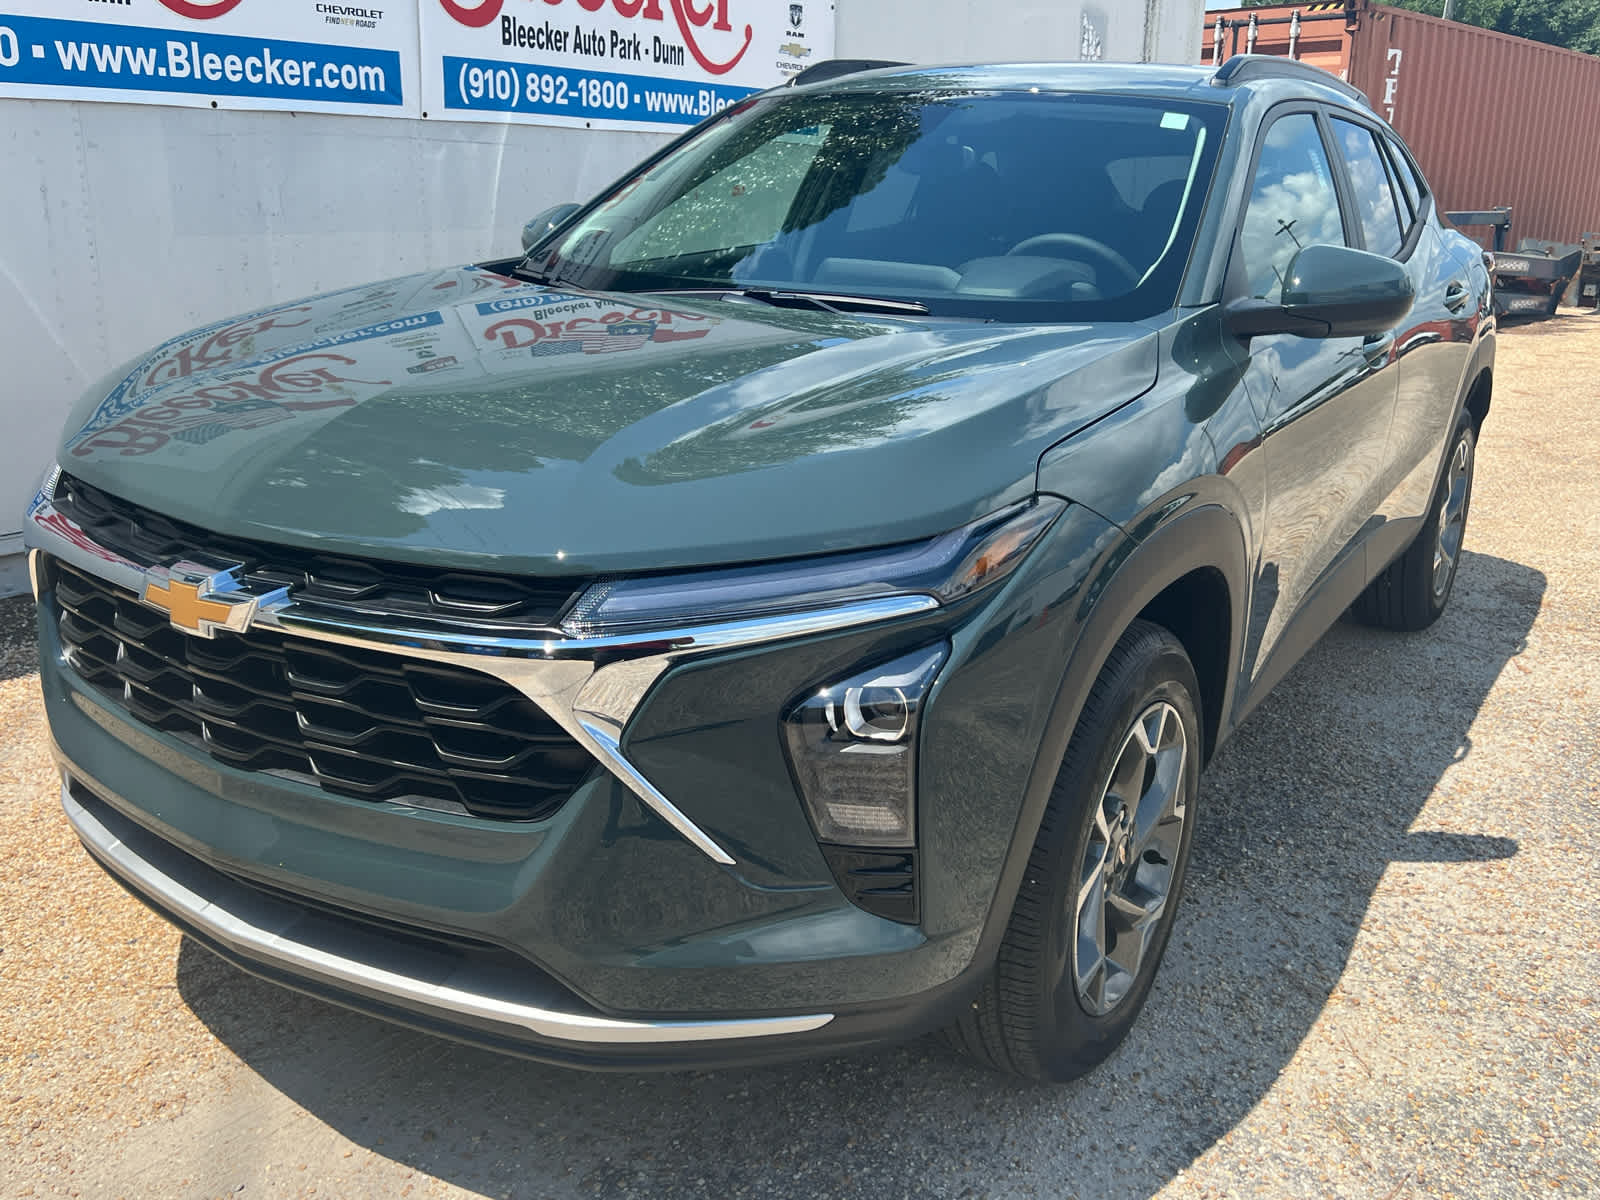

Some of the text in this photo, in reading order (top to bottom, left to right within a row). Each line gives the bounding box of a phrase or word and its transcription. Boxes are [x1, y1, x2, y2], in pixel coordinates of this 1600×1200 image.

[316, 3, 384, 19] CHEVROLET
[786, 30, 804, 38] RAM
[501, 15, 569, 52] Bleecker
[573, 25, 606, 57] Auto
[610, 30, 641, 61] Park
[653, 35, 685, 66] Dunn
[54, 40, 386, 92] www.Bleecker.com
[458, 63, 520, 107] (910)
[526, 73, 628, 110] 892-1800
